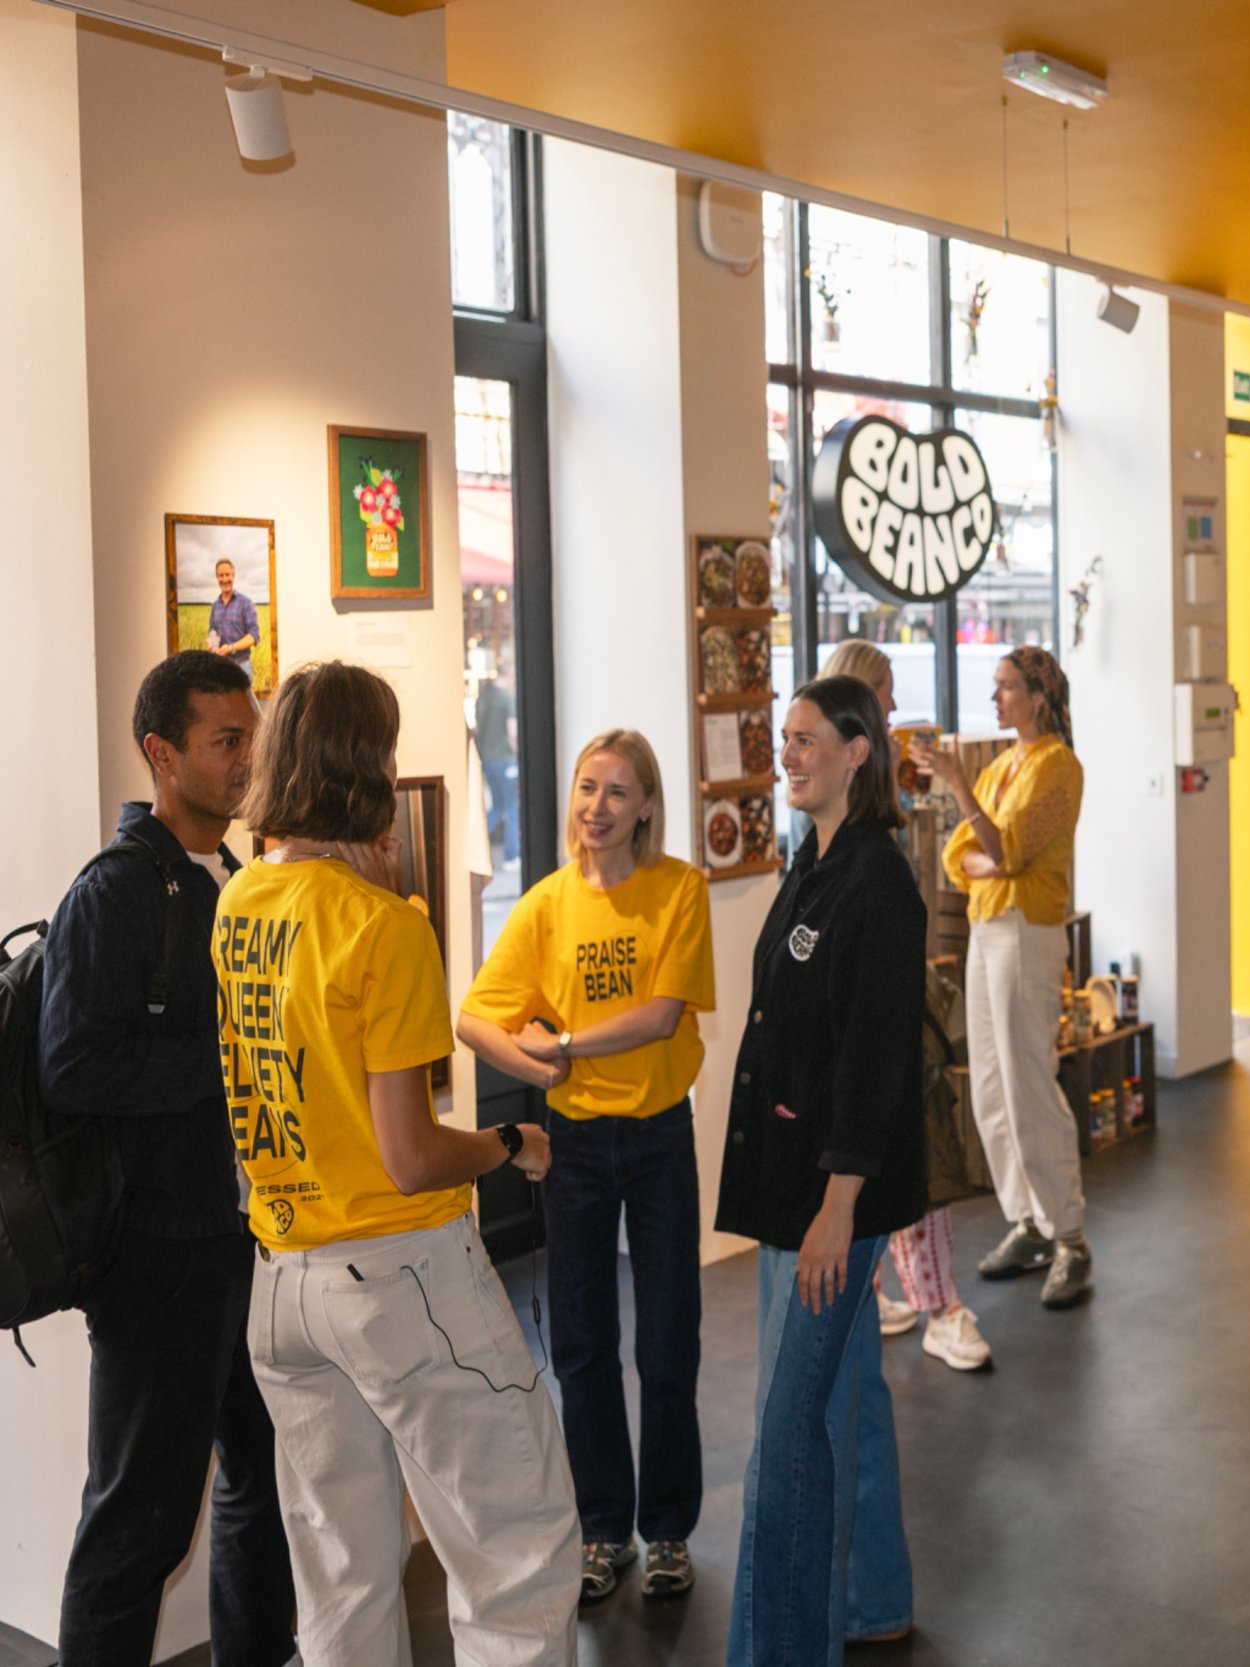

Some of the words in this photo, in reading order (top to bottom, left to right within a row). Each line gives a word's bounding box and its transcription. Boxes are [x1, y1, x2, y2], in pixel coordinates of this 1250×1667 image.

[849, 422, 985, 514] BOLD
[217, 915, 302, 977] REAMY
[576, 936, 637, 972] PRAISE
[585, 968, 633, 1002] BEAN
[219, 1043, 305, 1102] ELVETY
[230, 1103, 306, 1162] EANS
[256, 1182, 320, 1195] ESSED
